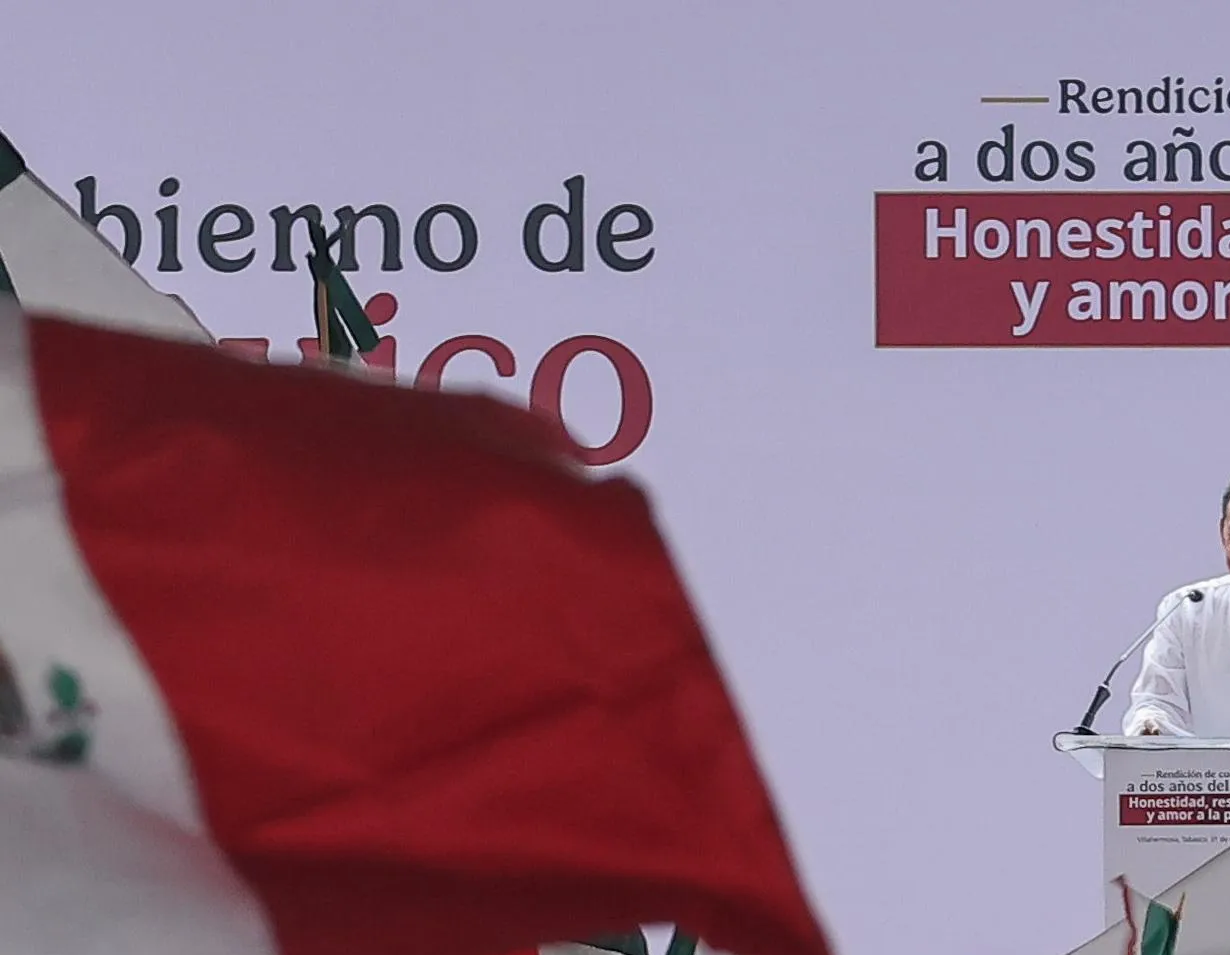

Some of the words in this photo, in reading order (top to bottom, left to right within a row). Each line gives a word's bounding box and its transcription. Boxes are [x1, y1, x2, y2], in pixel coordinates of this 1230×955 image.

[914, 140, 948, 182] a
[976, 123, 1096, 183] dos
[75, 175, 479, 274] bierno
[522, 174, 656, 274] de
[1010, 275, 1050, 336] y
[1155, 769, 1203, 779] Rendición
[1204, 769, 1216, 779] de
[1126, 783, 1135, 793] a
[1139, 779, 1165, 793] dos
[1168, 780, 1203, 793] años
[1207, 779, 1229, 793] del
[1128, 796, 1210, 810] Honestidad,
[1146, 811, 1155, 824] y
[1157, 811, 1194, 822] amor
[1196, 811, 1205, 822] a
[1208, 808, 1221, 822] la
